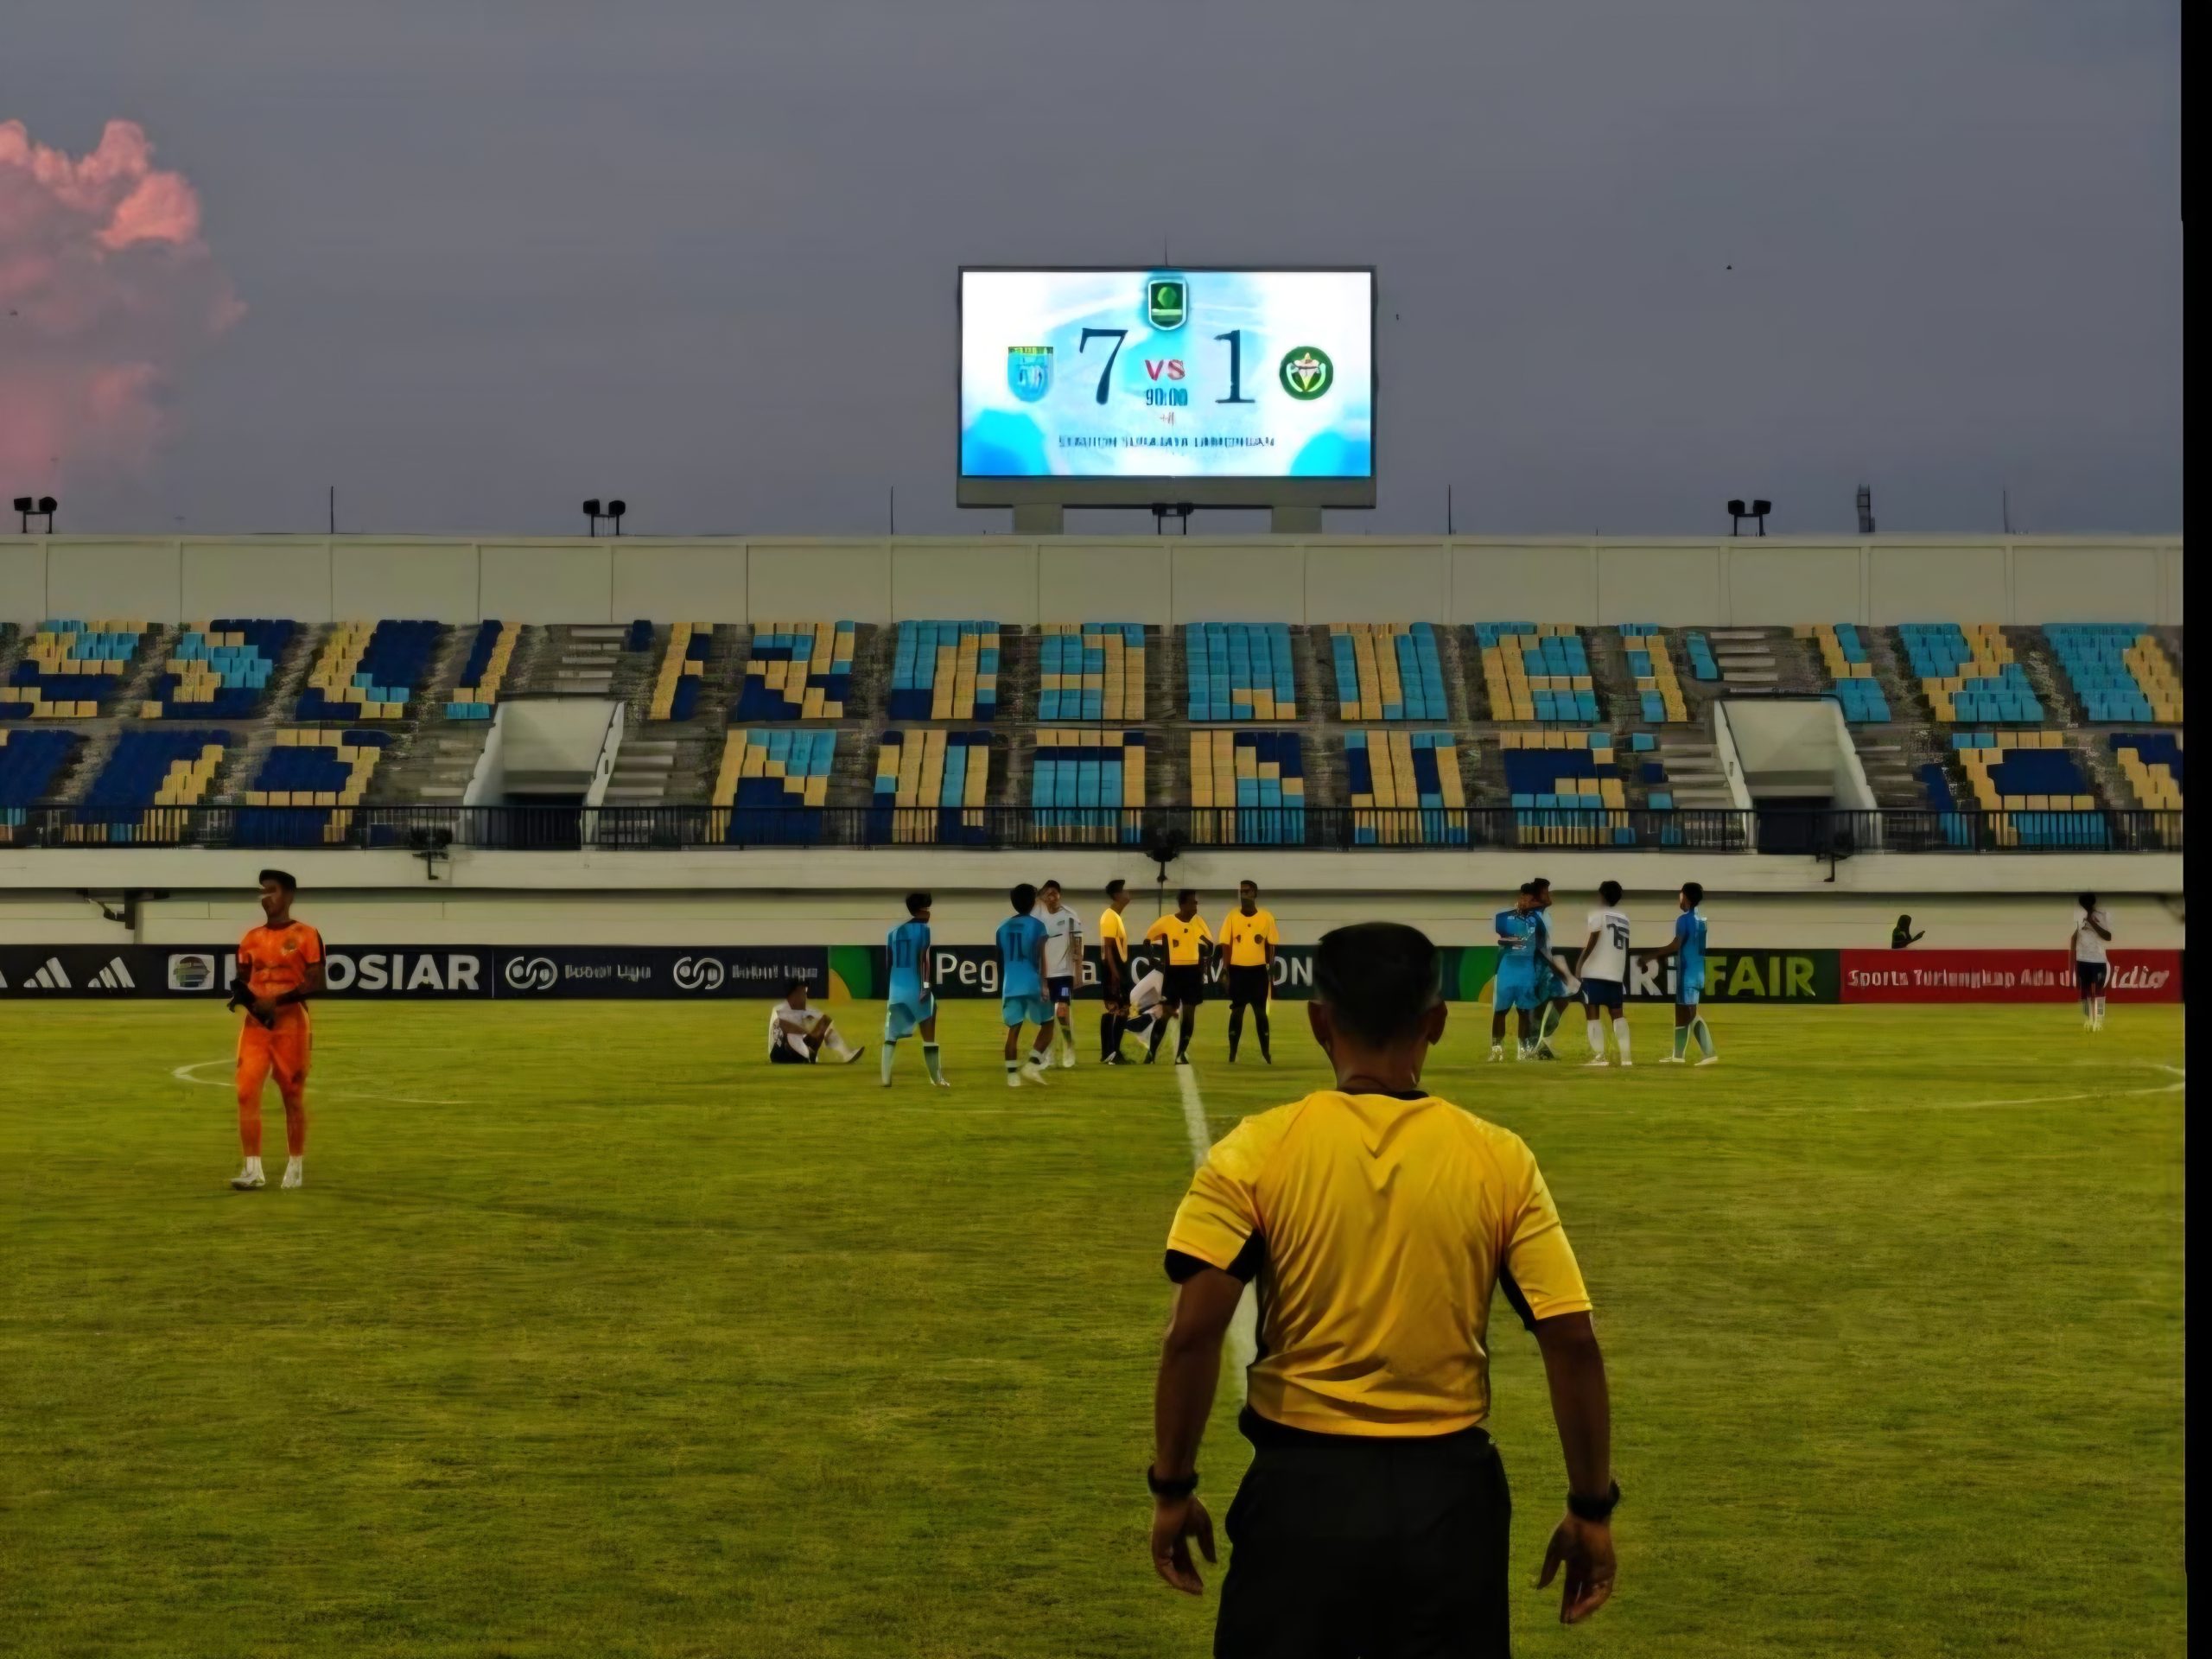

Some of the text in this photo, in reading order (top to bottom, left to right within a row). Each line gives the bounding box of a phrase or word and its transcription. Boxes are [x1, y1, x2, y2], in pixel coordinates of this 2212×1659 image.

[1079, 327, 1255, 404] 7 VS 1
[1704, 956, 1816, 997] FAIR
